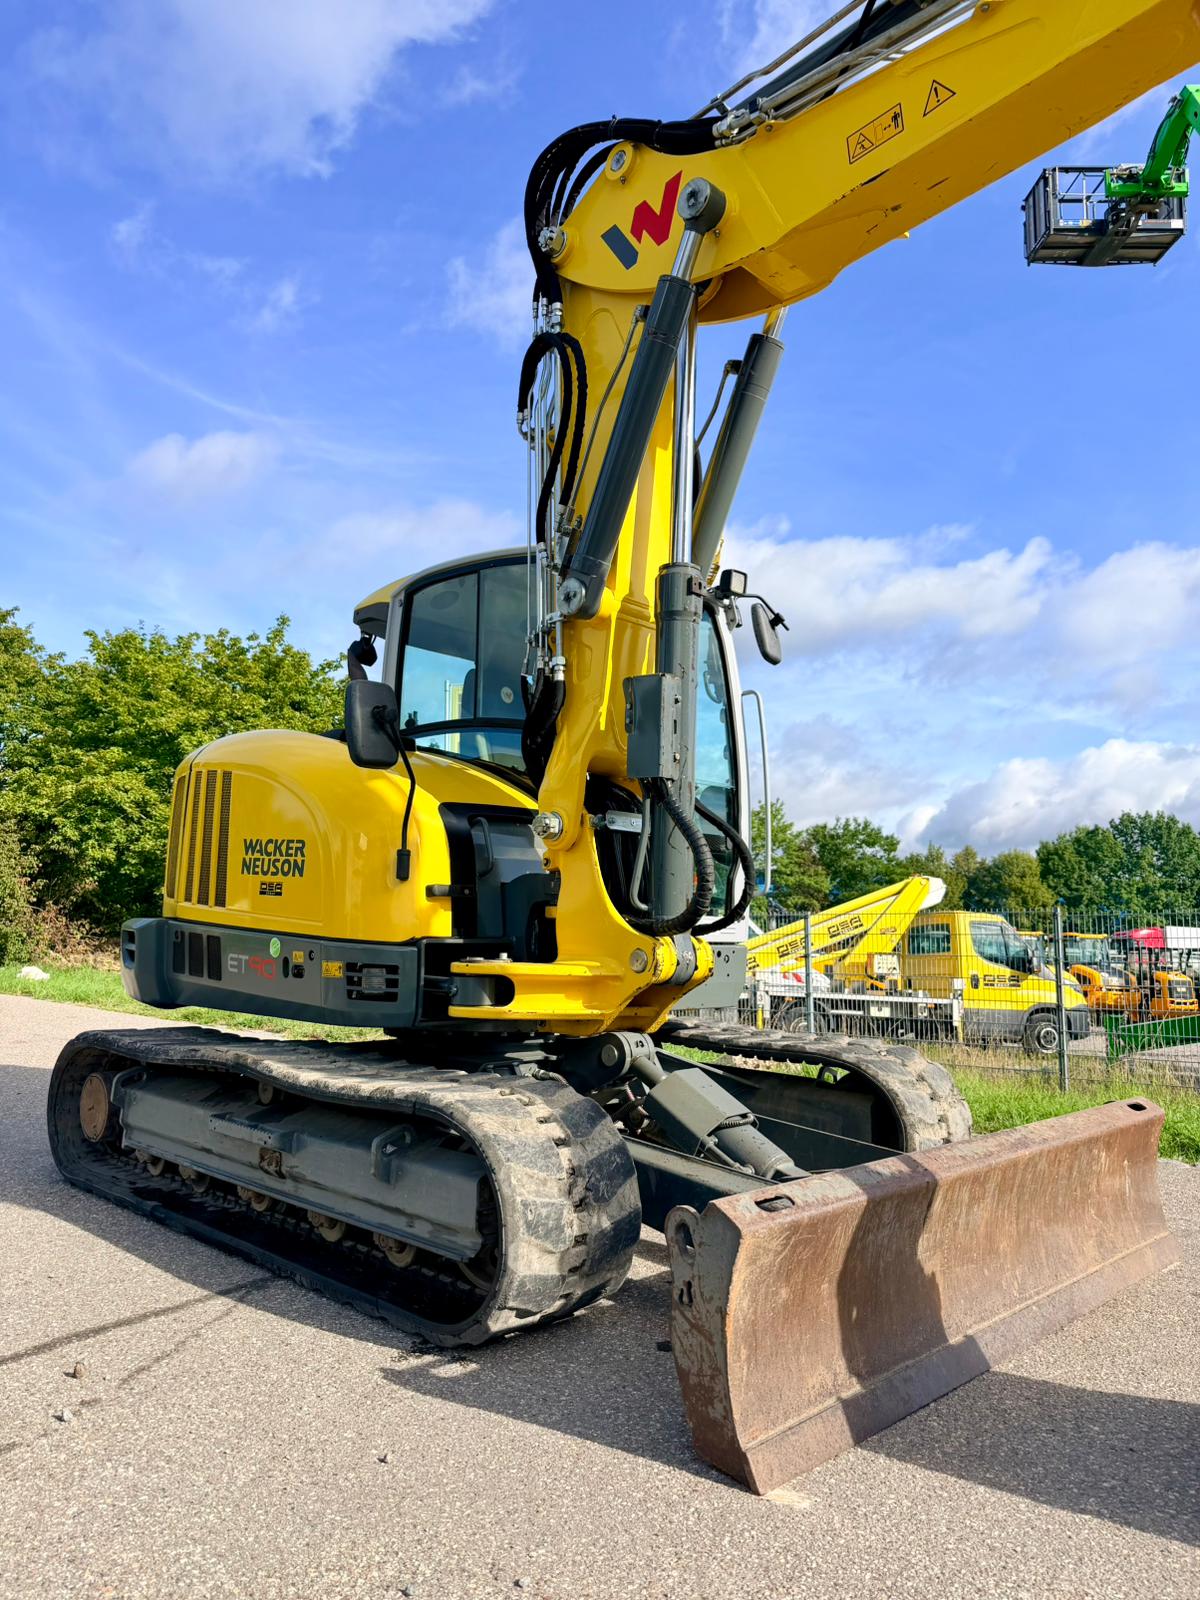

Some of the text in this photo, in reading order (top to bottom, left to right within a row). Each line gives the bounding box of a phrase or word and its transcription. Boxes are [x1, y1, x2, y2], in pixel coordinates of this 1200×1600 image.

[243, 838, 306, 857] WACKER
[241, 857, 305, 877] NEUSON
[227, 953, 277, 980] ET90
